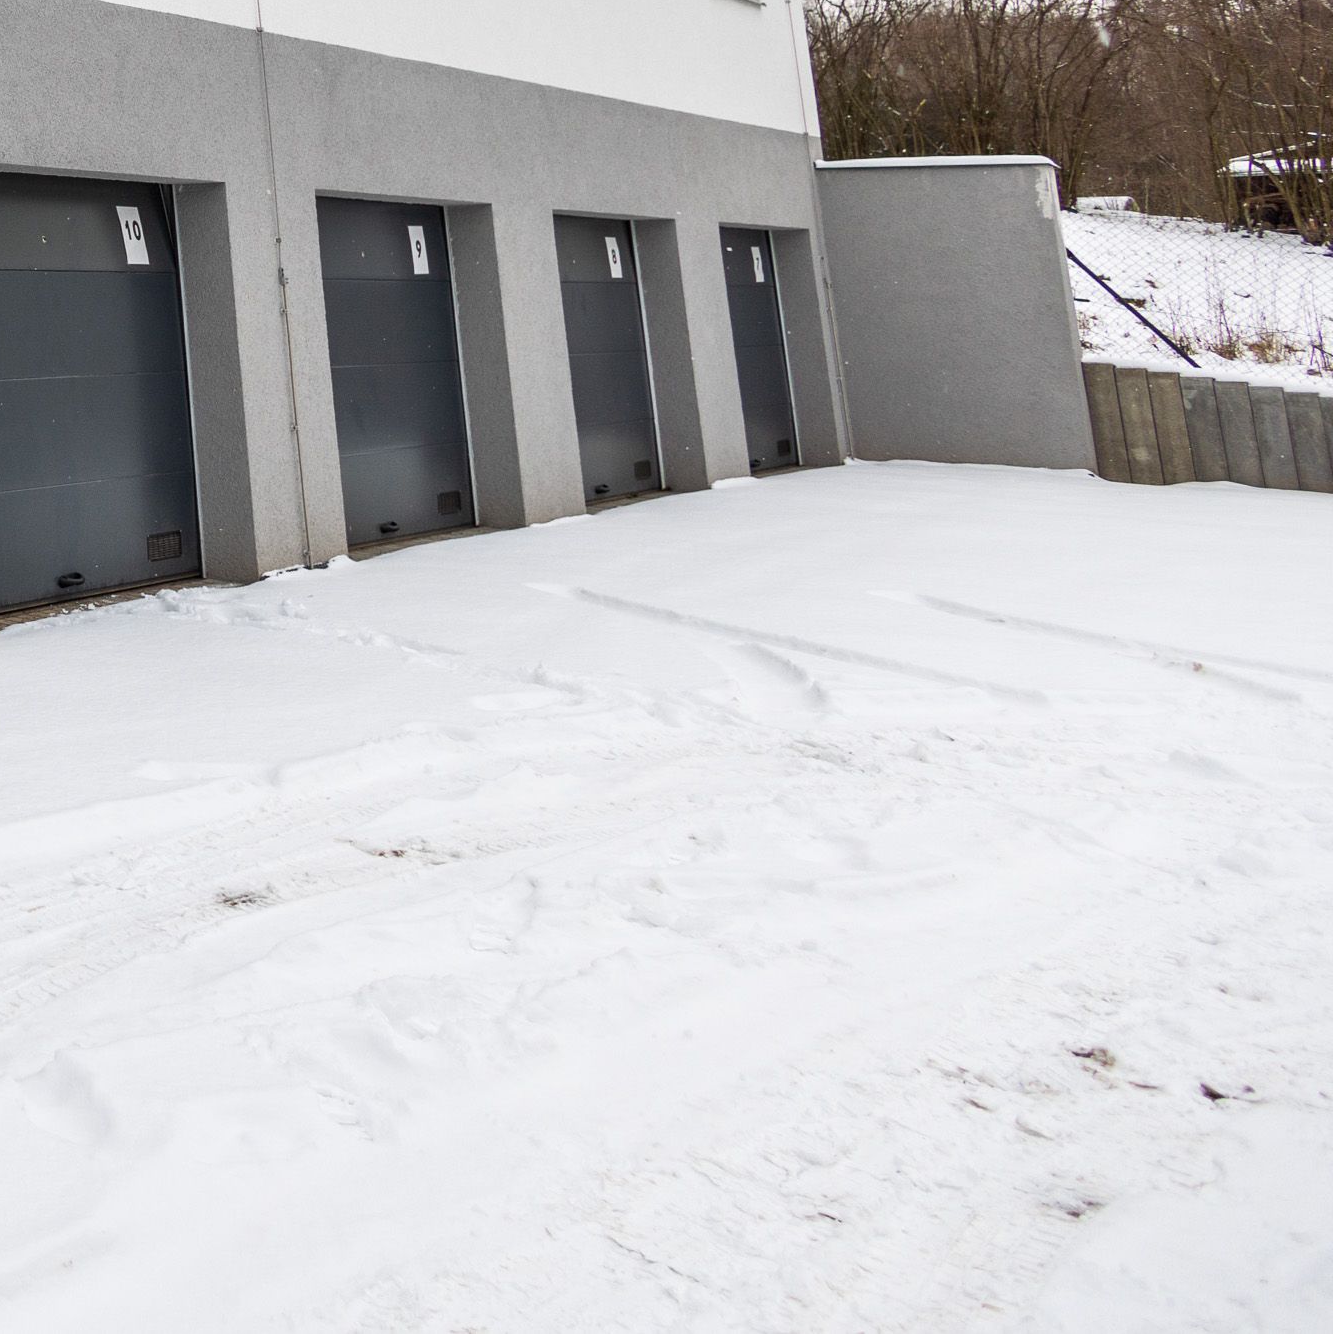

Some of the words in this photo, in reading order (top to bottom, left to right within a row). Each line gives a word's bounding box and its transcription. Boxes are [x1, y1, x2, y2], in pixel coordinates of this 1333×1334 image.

[125, 220, 142, 241] 10
[415, 239, 422, 258] 9
[611, 249, 617, 265] 8
